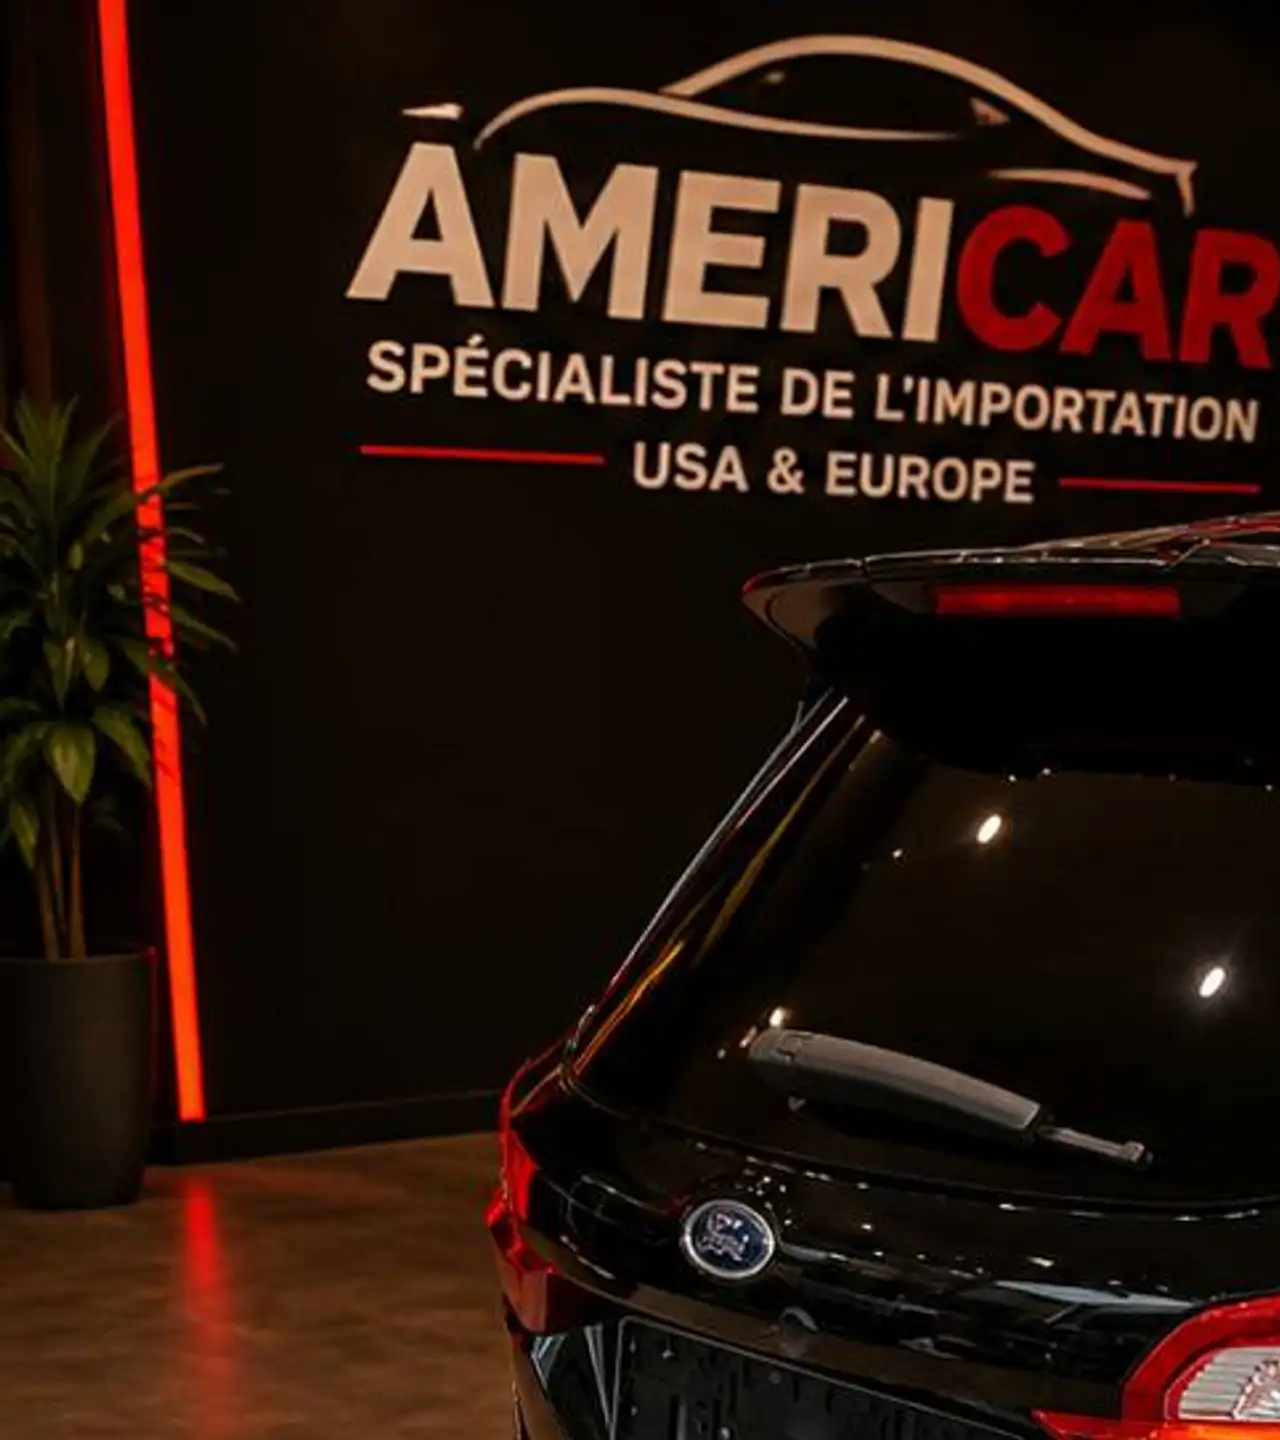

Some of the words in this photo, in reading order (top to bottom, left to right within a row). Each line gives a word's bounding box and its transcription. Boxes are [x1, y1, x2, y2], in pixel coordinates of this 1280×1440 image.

[366, 334, 760, 414] SPÉCIALISTE
[780, 367, 856, 418] DE
[876, 373, 1258, 443] L'IMPORTATION
[633, 442, 749, 492] USA
[766, 447, 805, 494] &
[826, 451, 1036, 504] EUROPE
